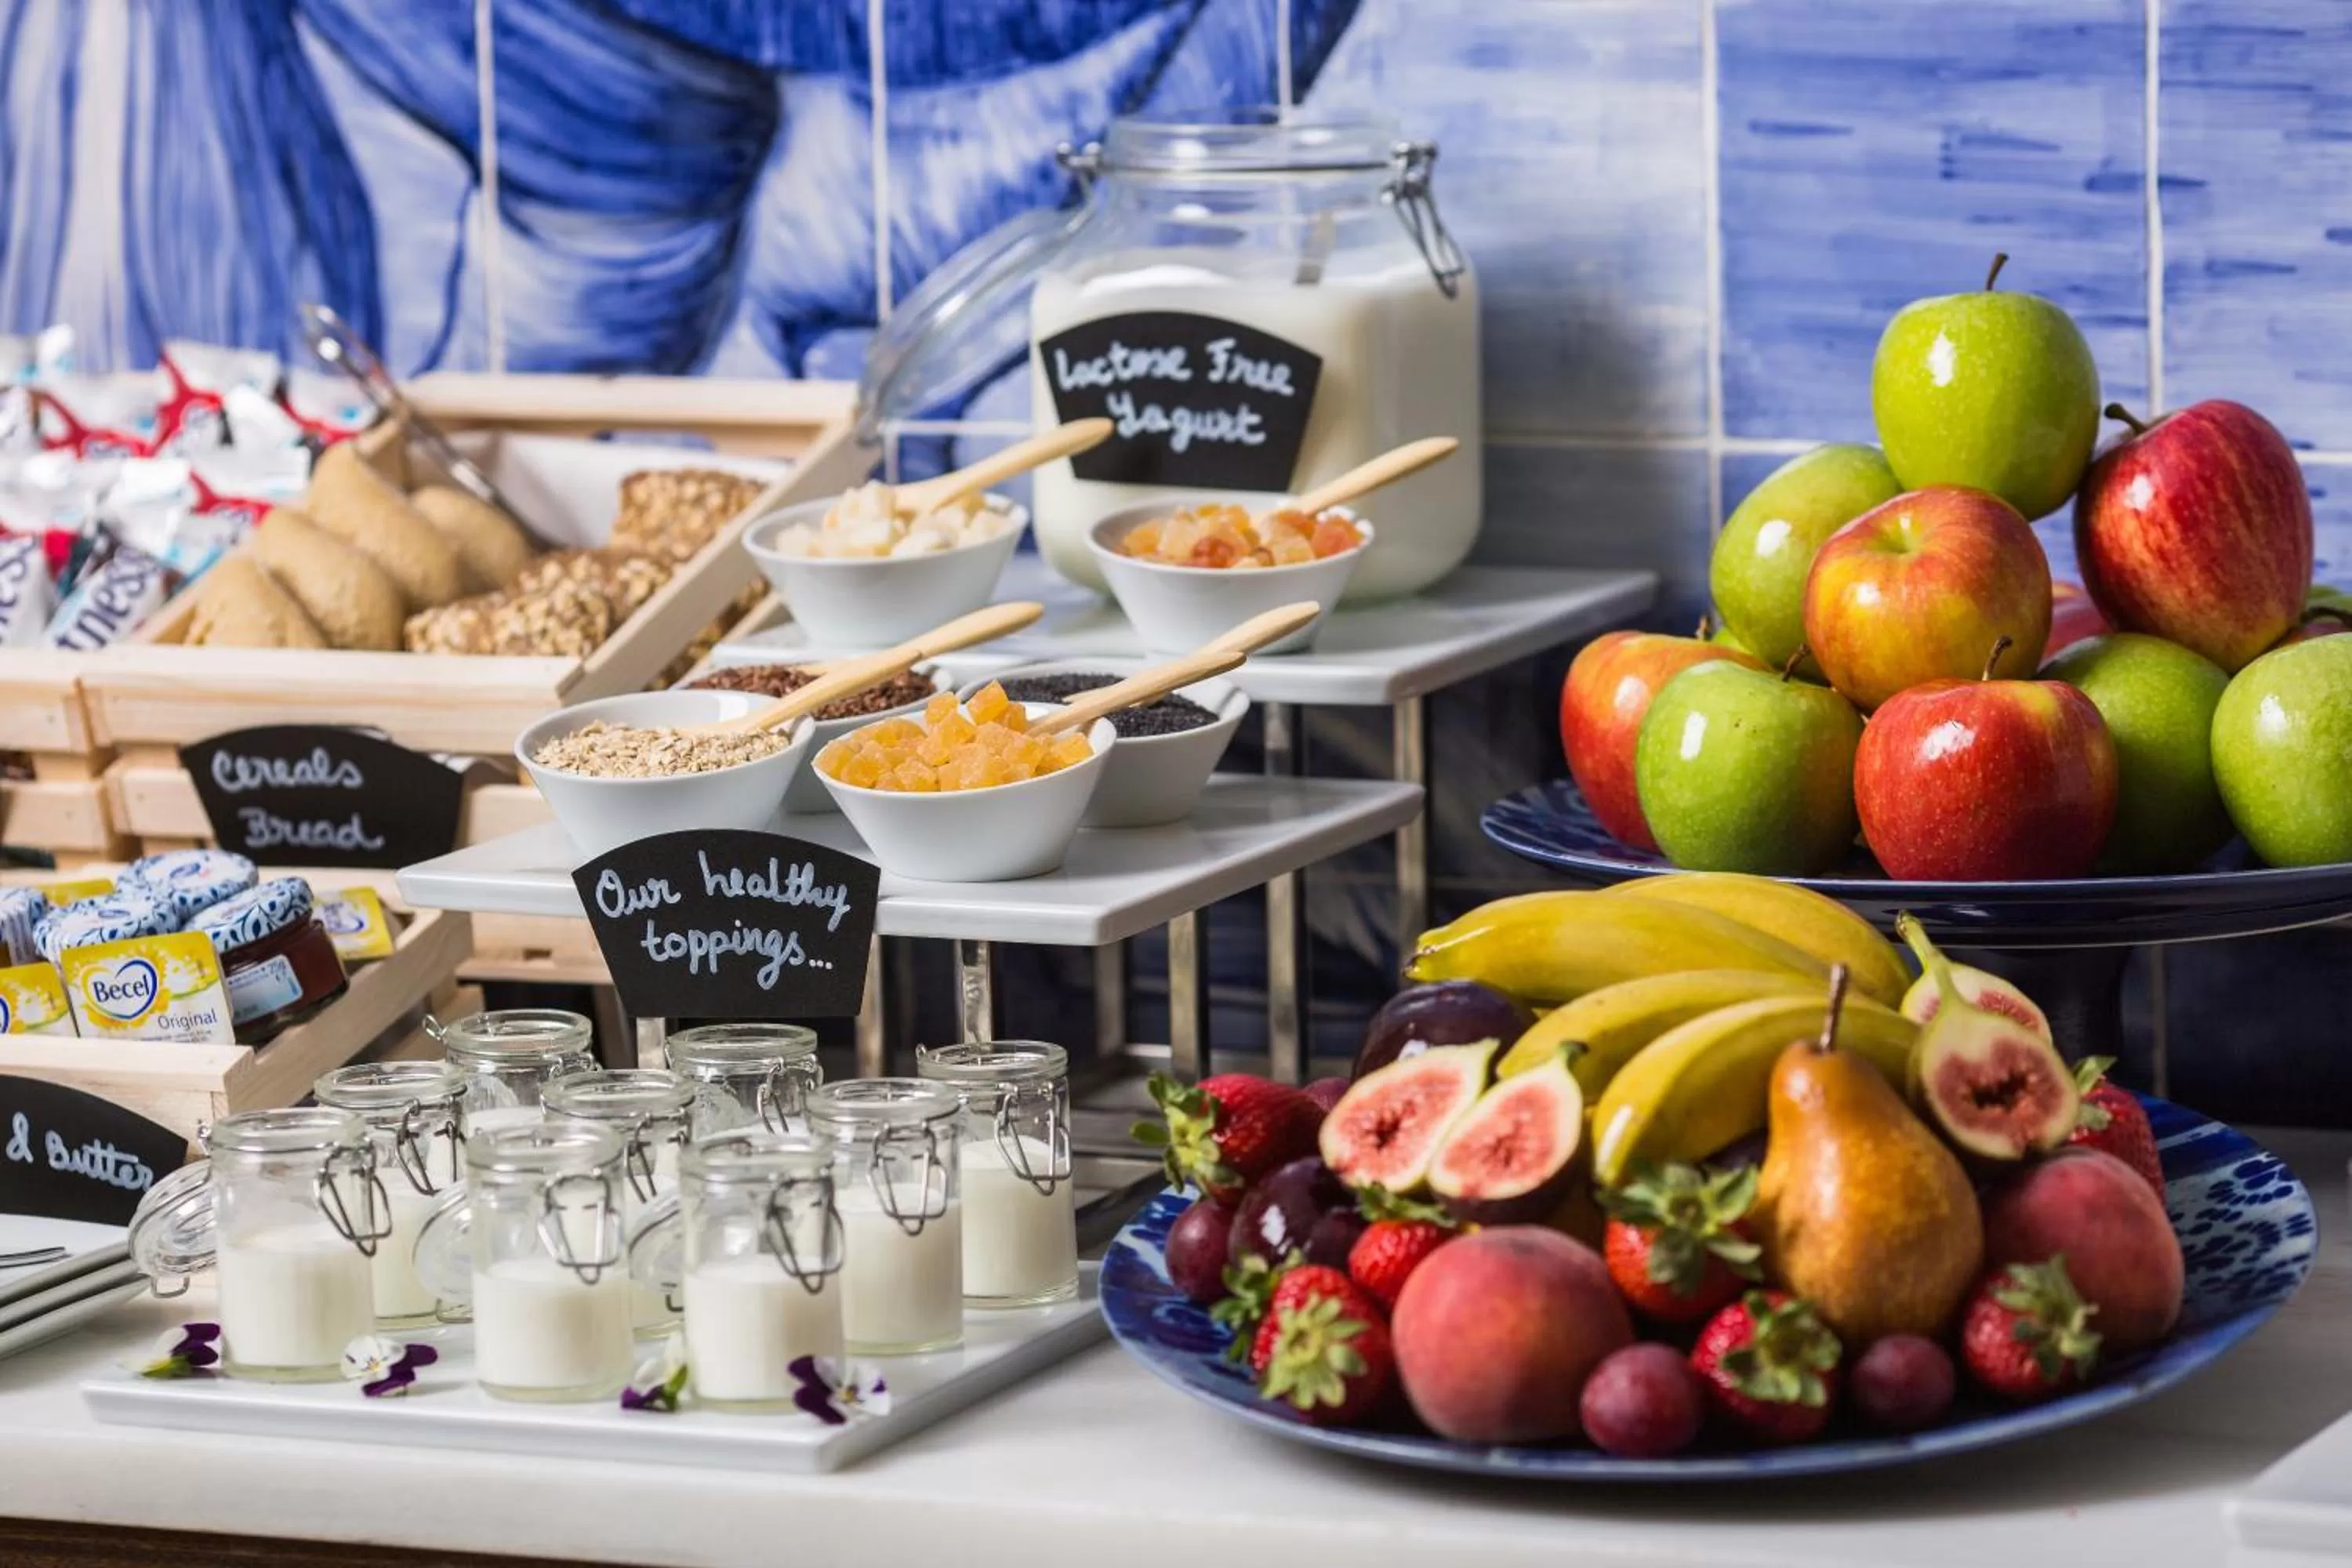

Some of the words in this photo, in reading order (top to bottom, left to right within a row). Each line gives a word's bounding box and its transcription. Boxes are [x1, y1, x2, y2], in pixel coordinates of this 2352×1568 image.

[1054, 339, 1192, 390] Lactose
[1205, 336, 1295, 397] Free
[211, 748, 364, 793] Cereals
[238, 808, 386, 850] Bread
[595, 868, 681, 919] Our
[698, 849, 851, 932] healthy
[93, 974, 150, 1003] Becel
[158, 1008, 217, 1030] Original
